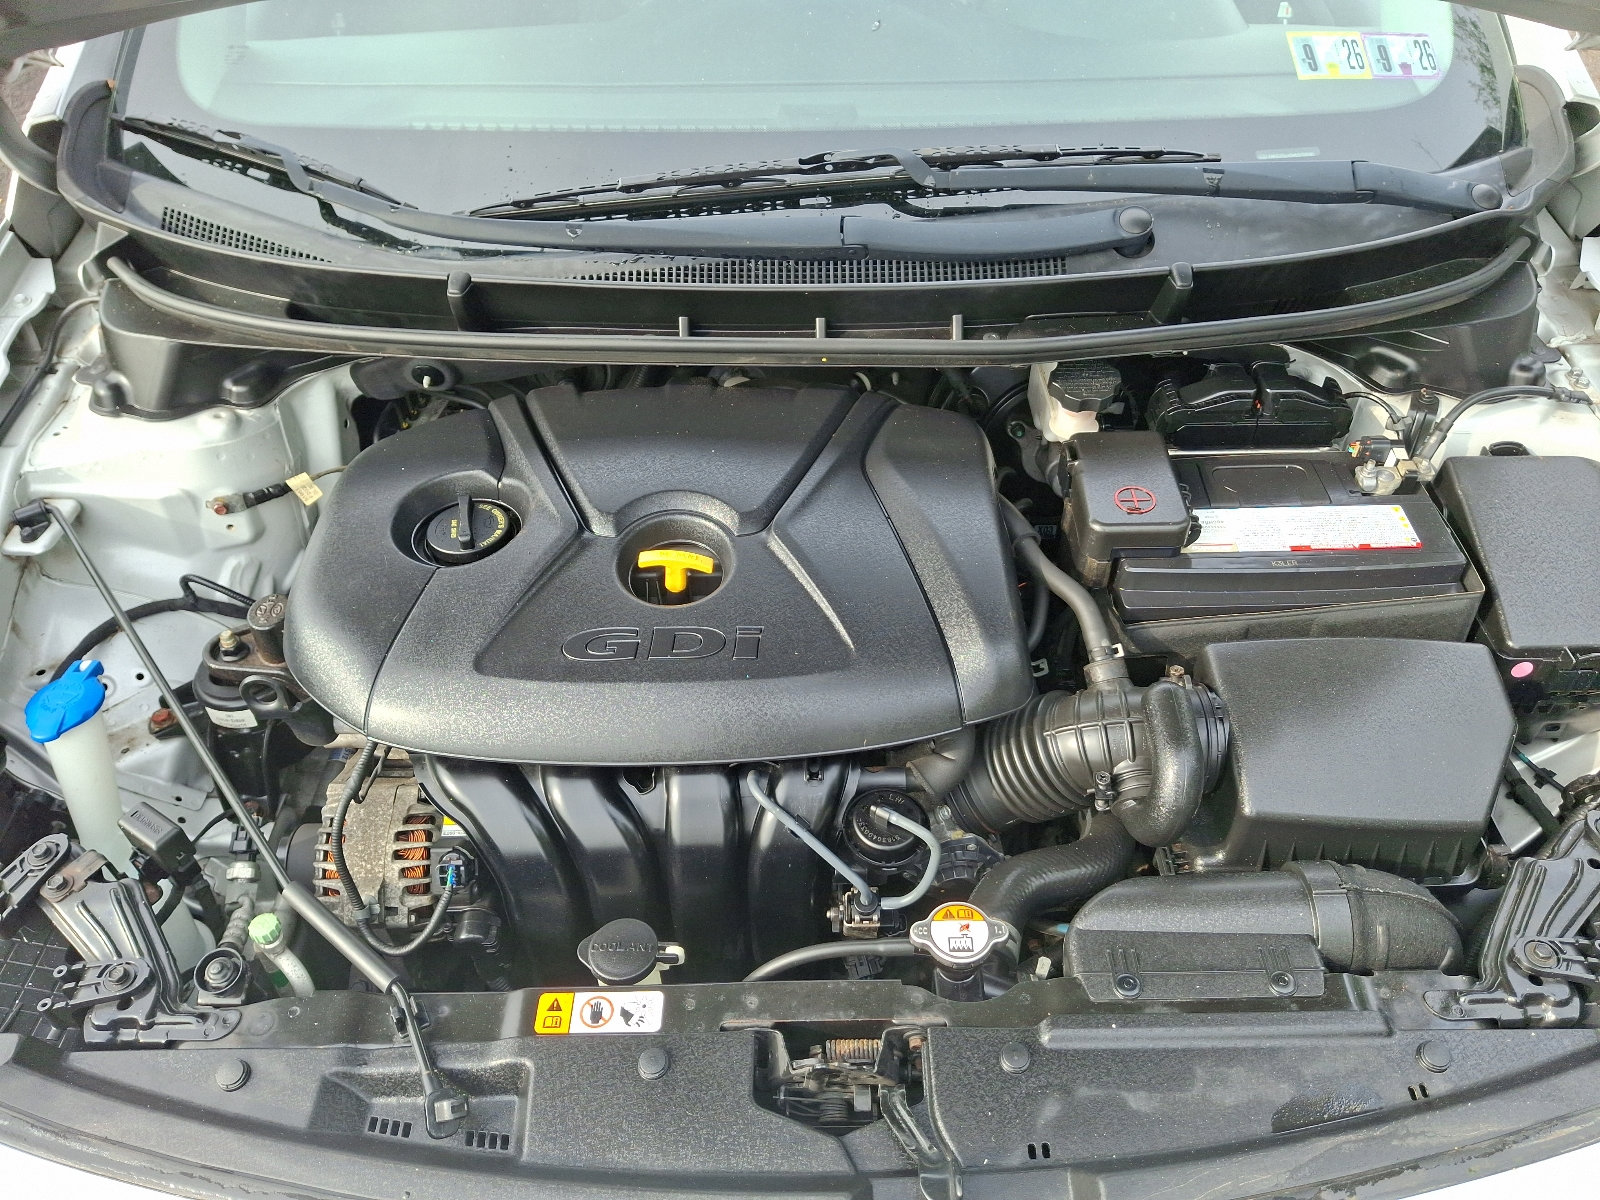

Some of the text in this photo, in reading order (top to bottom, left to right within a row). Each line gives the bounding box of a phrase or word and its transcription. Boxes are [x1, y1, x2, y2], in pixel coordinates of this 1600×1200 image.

[1302, 39, 1365, 72] 9 26
[1377, 39, 1437, 73] 9 26
[561, 625, 765, 661] GDi
[590, 942, 654, 953] COOLANT
